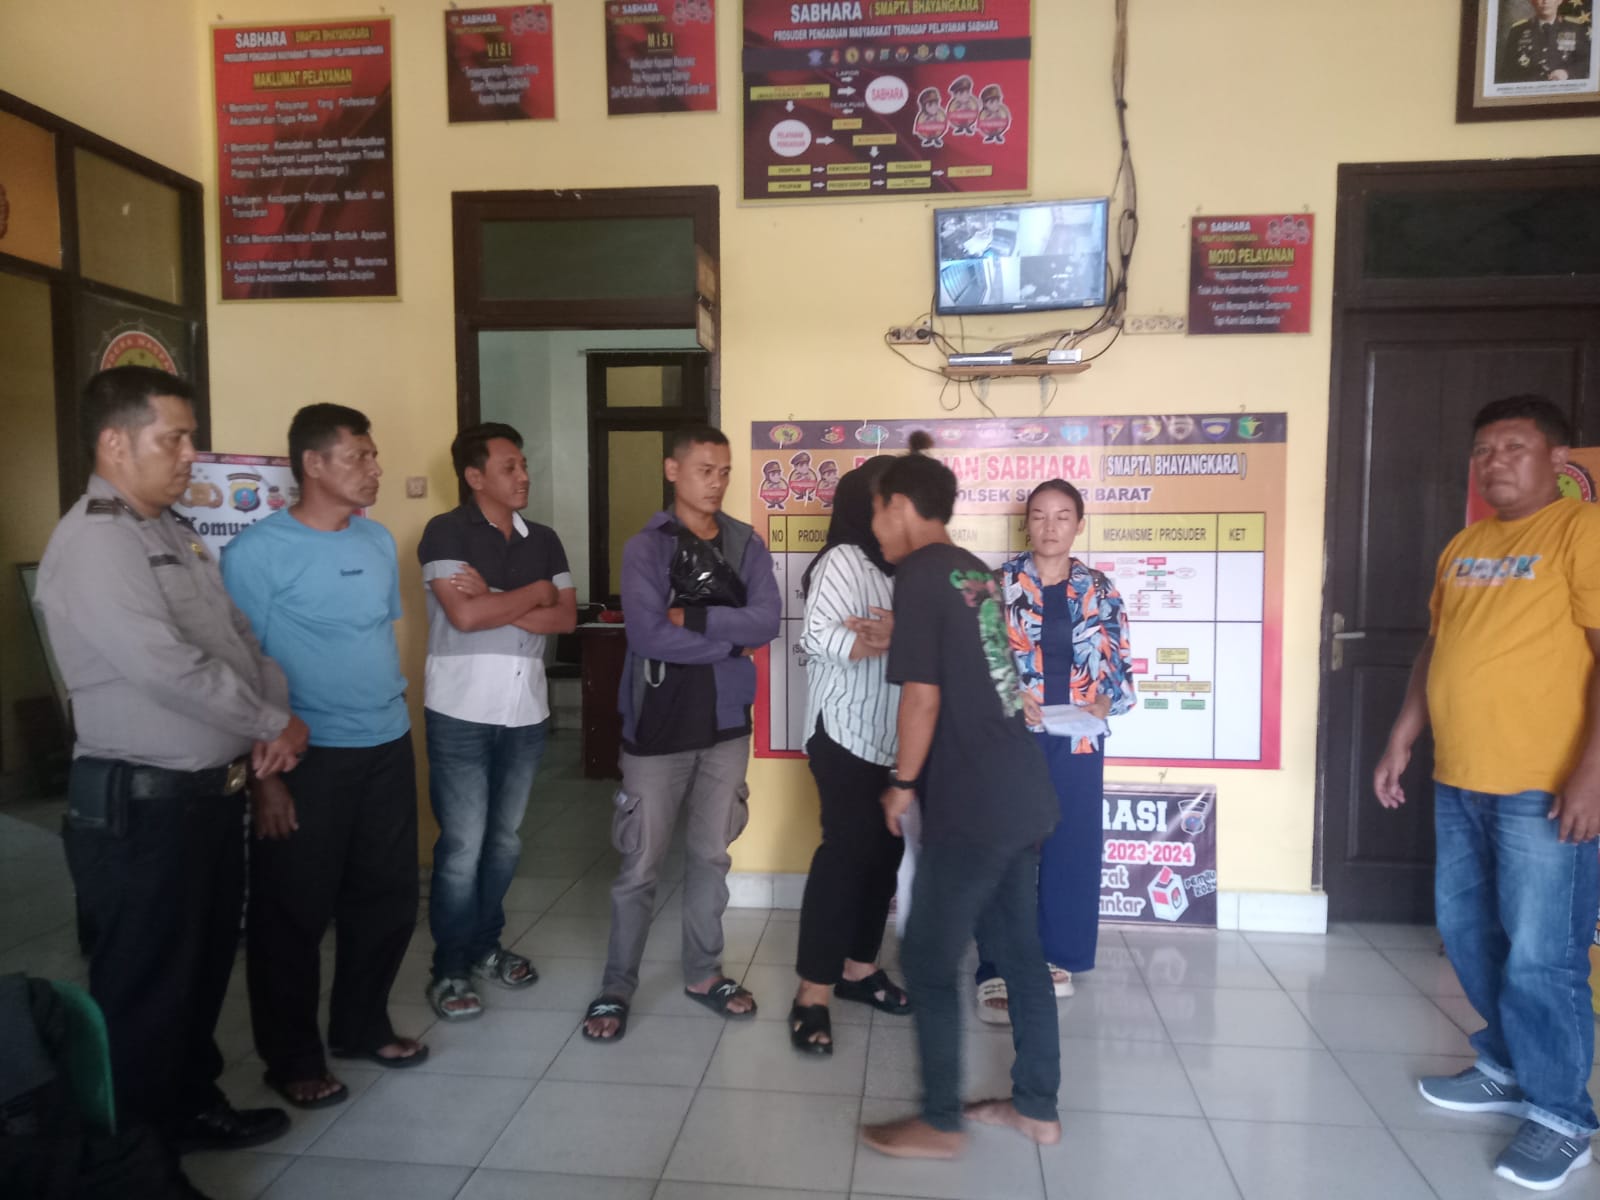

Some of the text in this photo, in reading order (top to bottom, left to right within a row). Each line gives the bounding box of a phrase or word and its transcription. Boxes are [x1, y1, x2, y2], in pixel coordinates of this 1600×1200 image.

[791, 1, 862, 23] SABHARA
[235, 31, 287, 48] SABHARA
[254, 68, 351, 87] MAKLUMAT PELAYANAN
[871, 87, 904, 100] SABHARA
[1208, 247, 1295, 264] MOTO PELAYANAN
[987, 454, 1091, 480] SABHARA
[955, 488, 1011, 502] OLSEK
[1095, 487, 1151, 501] BARAT
[772, 529, 784, 541] NO
[798, 529, 826, 542] PRODU
[1103, 528, 1153, 541] MEKANISME
[1160, 528, 1206, 541] PROSUDER
[1229, 528, 1246, 541] KET
[1107, 842, 1192, 863] 2023-2024
